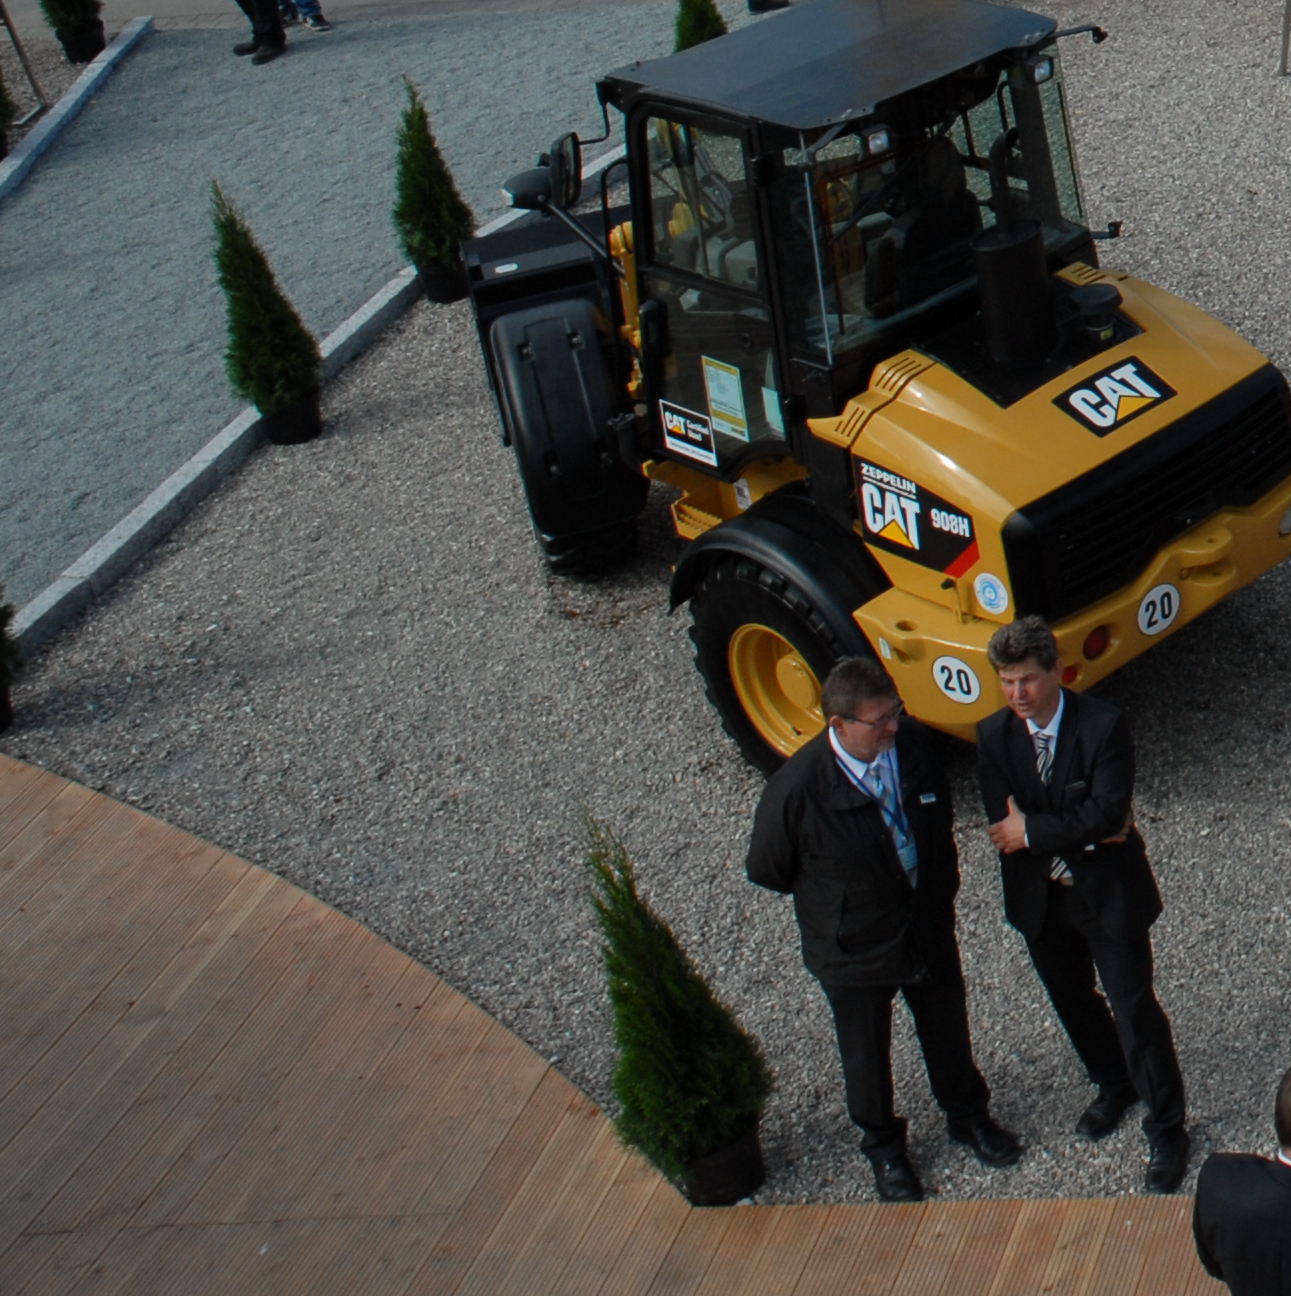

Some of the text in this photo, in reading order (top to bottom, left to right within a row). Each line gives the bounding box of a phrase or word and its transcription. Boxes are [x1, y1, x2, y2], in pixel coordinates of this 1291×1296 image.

[1069, 364, 1163, 428] CAT
[860, 462, 917, 494] ZEPPELIN
[861, 482, 921, 551] CAT
[930, 508, 971, 538] 908H
[1144, 588, 1175, 630] 20
[940, 664, 973, 697] 20
